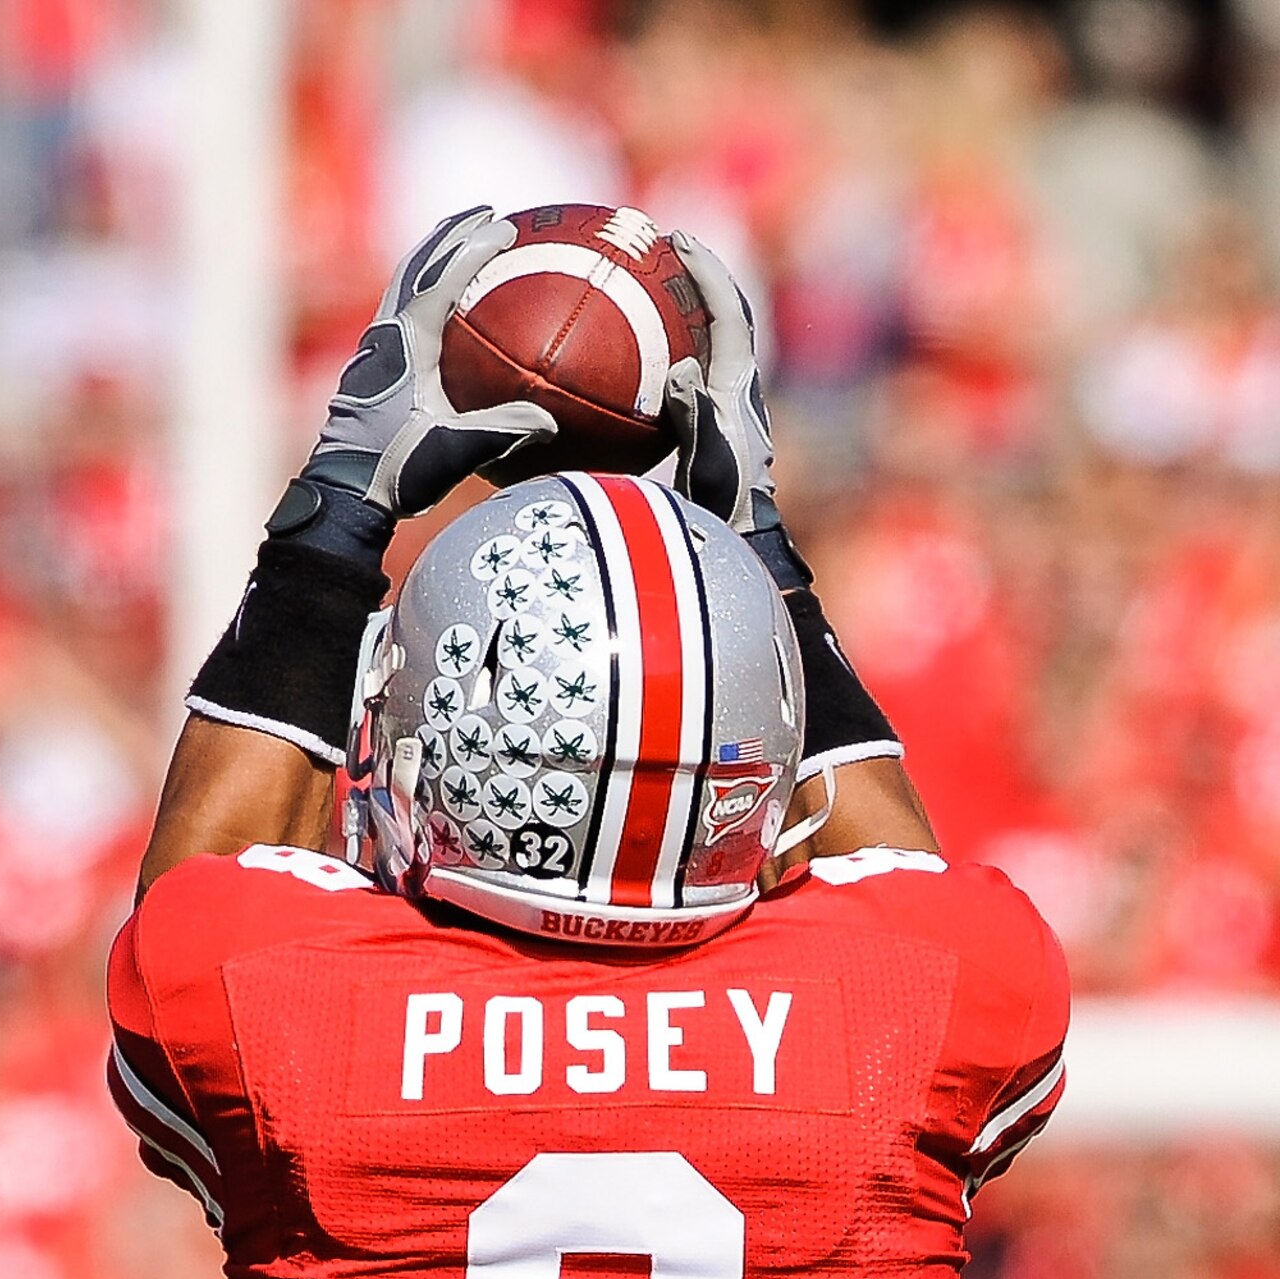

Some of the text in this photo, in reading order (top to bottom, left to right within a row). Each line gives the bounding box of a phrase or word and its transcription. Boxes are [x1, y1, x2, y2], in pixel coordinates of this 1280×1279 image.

[712, 793, 754, 817] NCAA
[516, 831, 570, 873] 32
[540, 910, 706, 943] BUCKEYES
[401, 989, 794, 1100] POSEY
